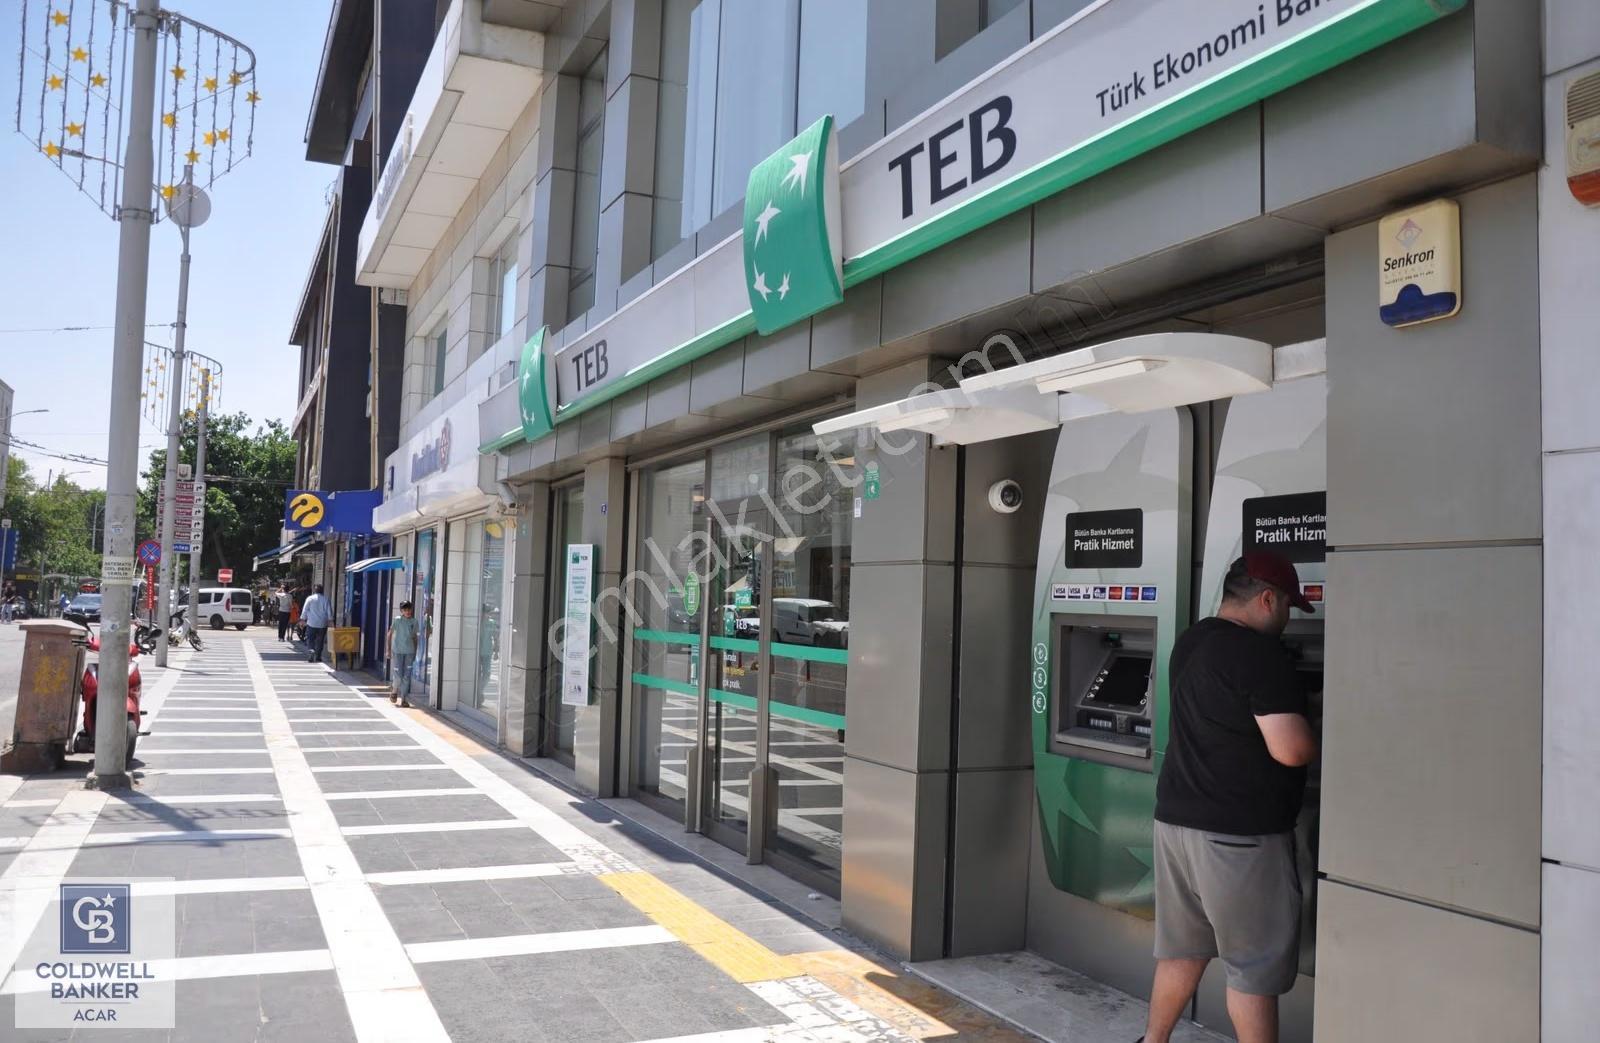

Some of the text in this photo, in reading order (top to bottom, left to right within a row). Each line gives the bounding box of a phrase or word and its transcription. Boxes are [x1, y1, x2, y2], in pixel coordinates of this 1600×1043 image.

[1096, 72, 1146, 117] Türk
[1153, 4, 1266, 89] Ekonomi
[888, 95, 1017, 220] TEB
[1384, 249, 1434, 273] Senkron
[572, 339, 609, 392] TEB
[1255, 517, 1277, 527] Bütün
[1278, 515, 1301, 525] Banka
[1074, 529, 1090, 537] Bütün
[1090, 528, 1107, 536] Banka
[1255, 528, 1291, 544] Pratik
[1074, 537, 1135, 552] Pratik Hizmet
